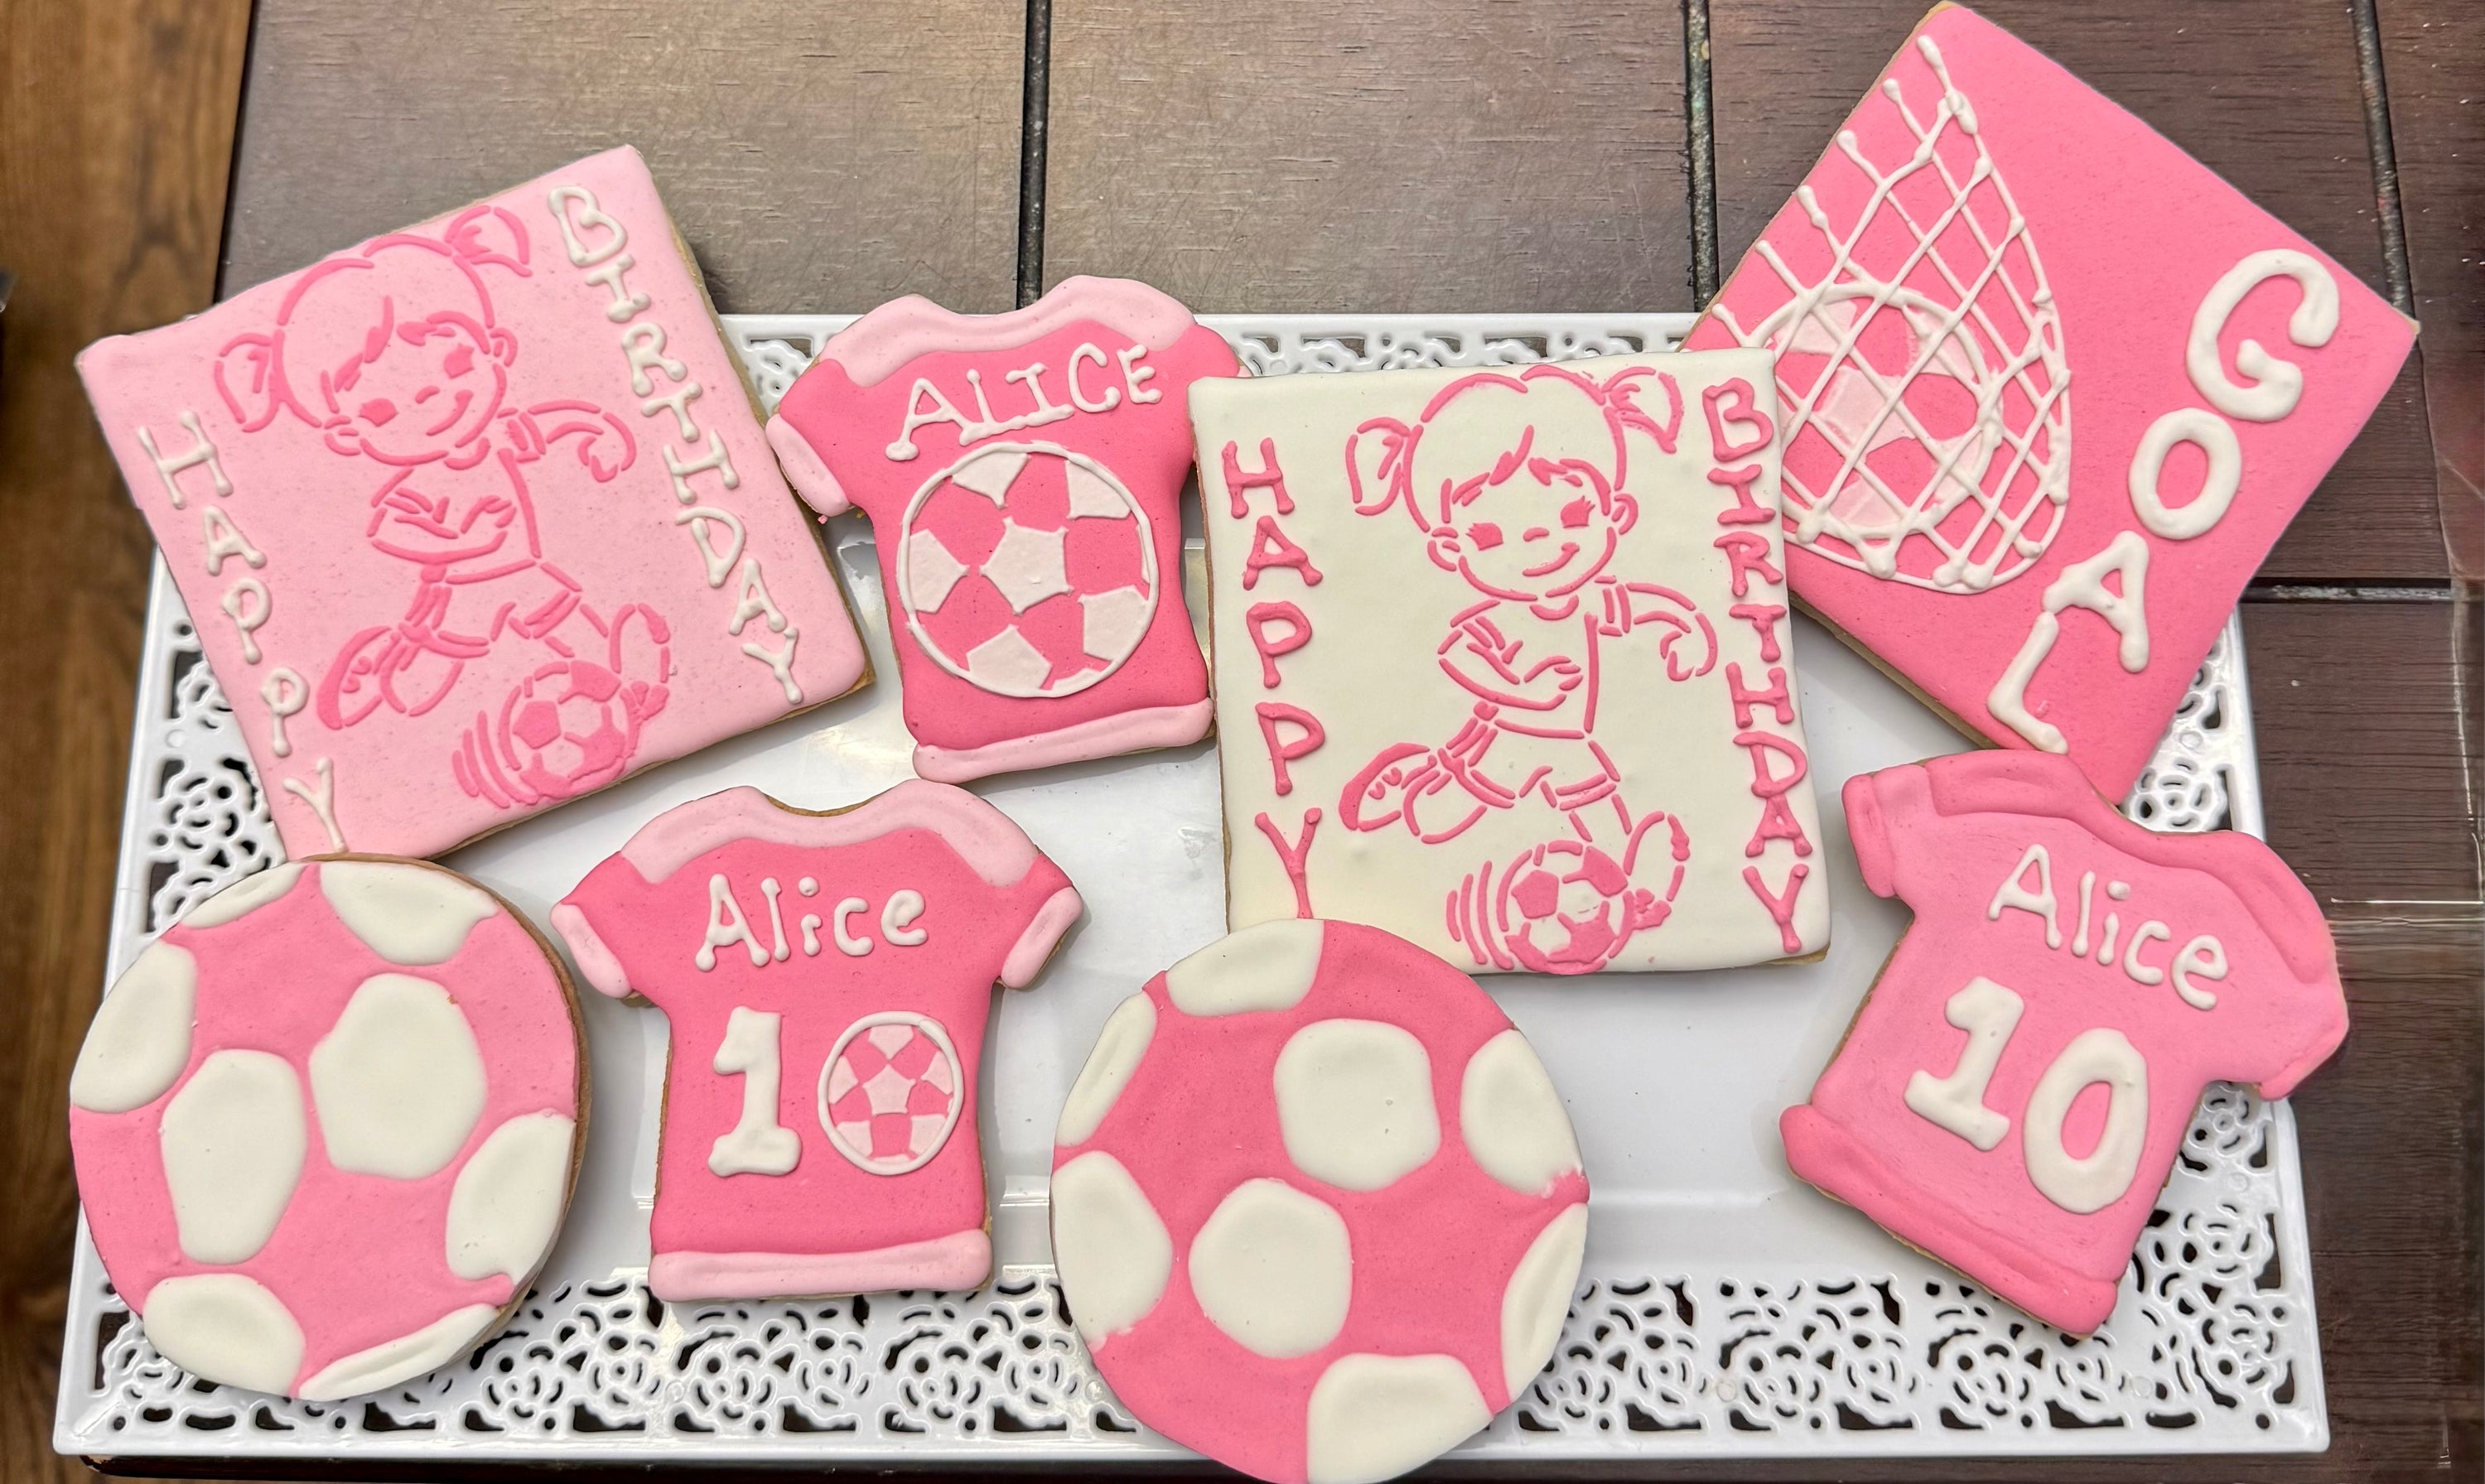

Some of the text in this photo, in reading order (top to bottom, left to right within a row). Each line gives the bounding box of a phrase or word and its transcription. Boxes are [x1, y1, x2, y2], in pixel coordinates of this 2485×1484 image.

[547, 185, 803, 704] BIRTHDAY
[885, 342, 1163, 461] ALICE
[1988, 248, 2340, 755] GOAL
[138, 411, 349, 853] HAPPY
[1221, 436, 1325, 919] HAPPY
[1701, 377, 1813, 953] BIRTHDAY
[694, 874, 929, 972] Alice
[1904, 976, 2148, 1214] 10
[1988, 844, 2228, 1011] Alice
